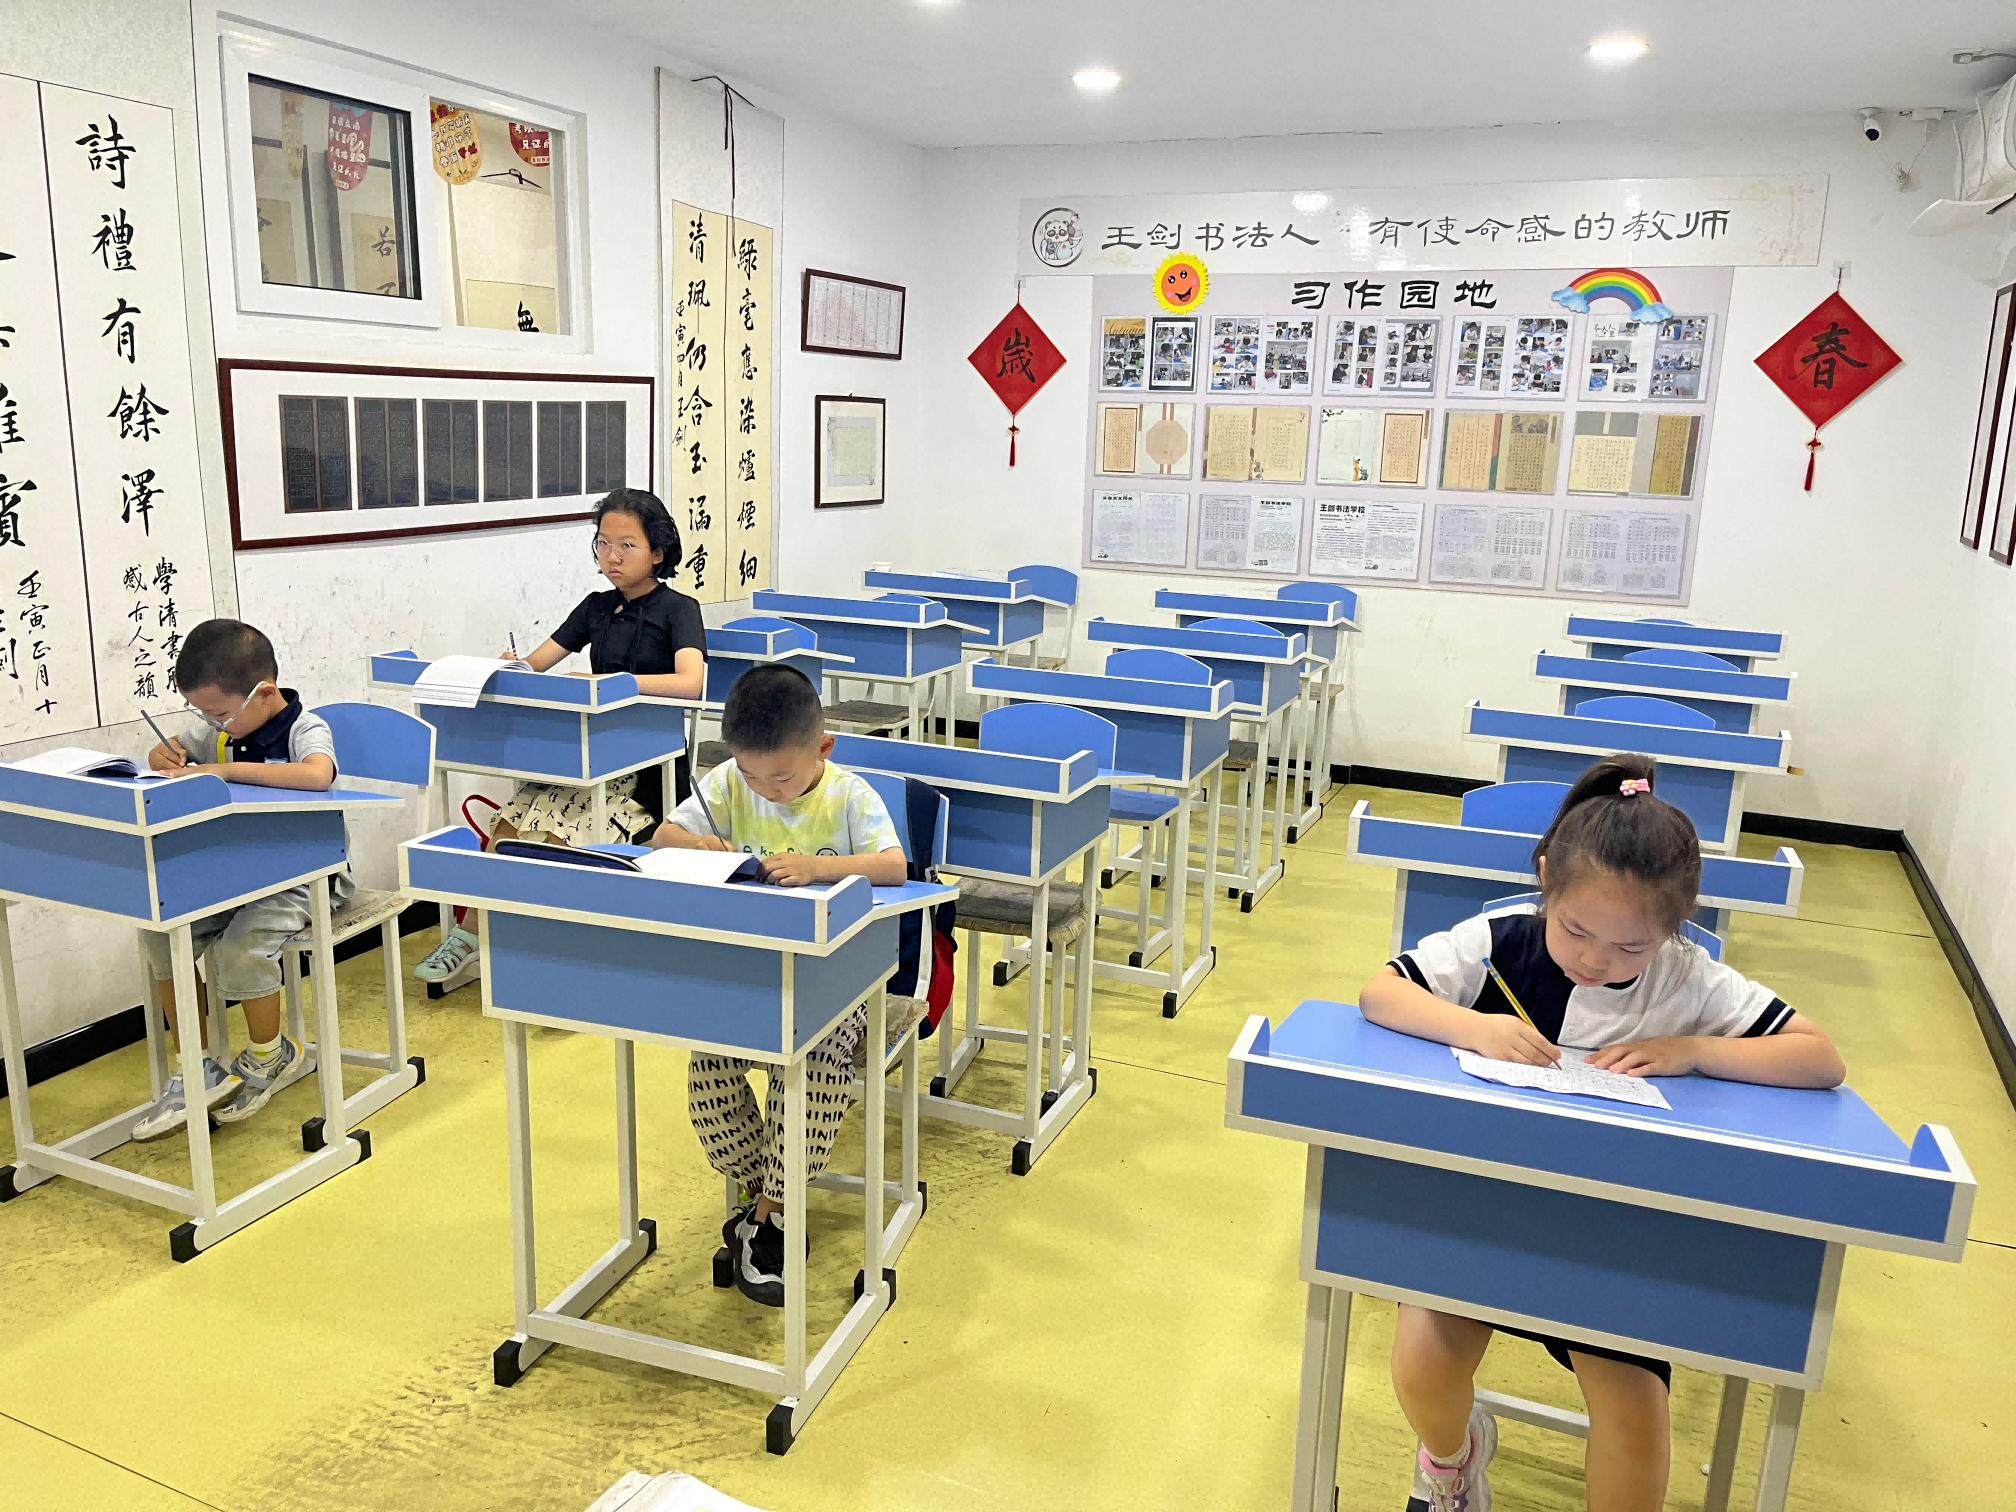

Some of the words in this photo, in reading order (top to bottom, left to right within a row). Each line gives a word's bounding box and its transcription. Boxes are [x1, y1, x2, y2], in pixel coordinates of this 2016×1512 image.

[75, 114, 170, 537] 詩禮有餘澤
[1292, 279, 1498, 310] 习作园地
[996, 327, 1036, 383] 歲
[1789, 322, 1868, 390] 春
